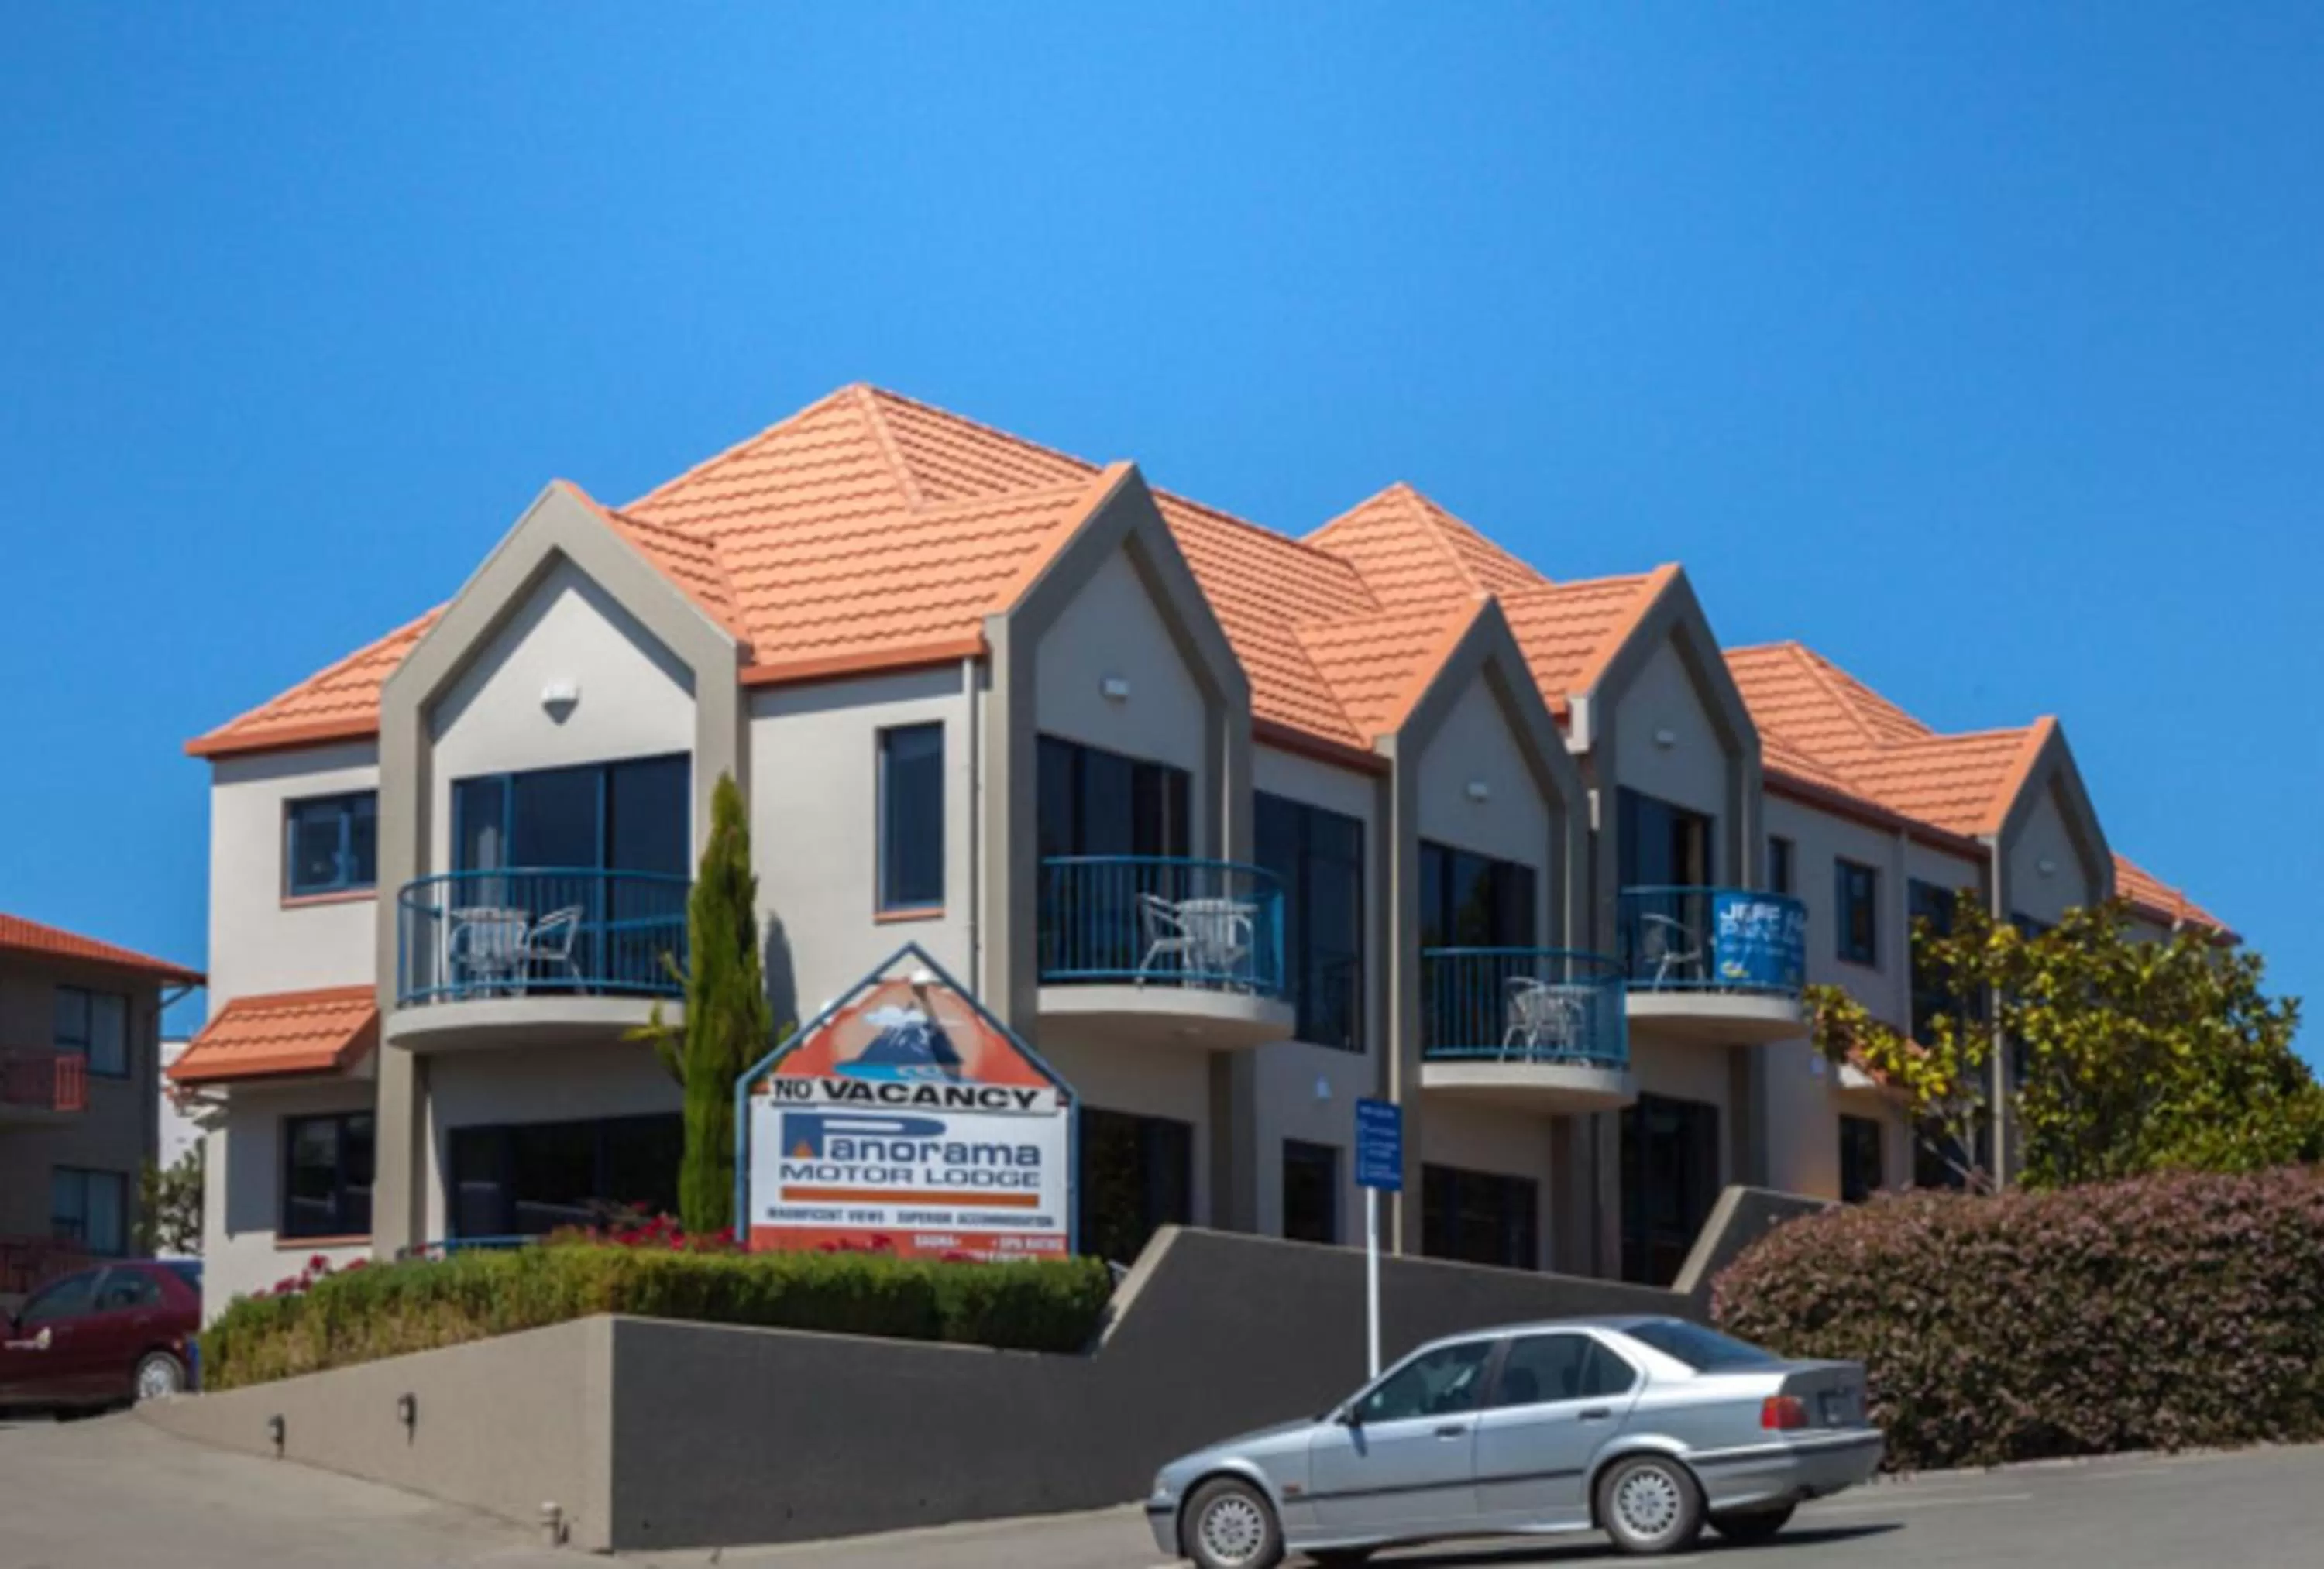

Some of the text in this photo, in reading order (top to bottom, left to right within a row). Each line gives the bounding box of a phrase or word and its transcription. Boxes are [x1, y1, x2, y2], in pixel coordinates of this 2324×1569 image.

[775, 1078, 1039, 1109] NO VACANCY
[780, 1112, 1042, 1166] Panorama
[779, 1164, 1041, 1188] MOTOR LODGE
